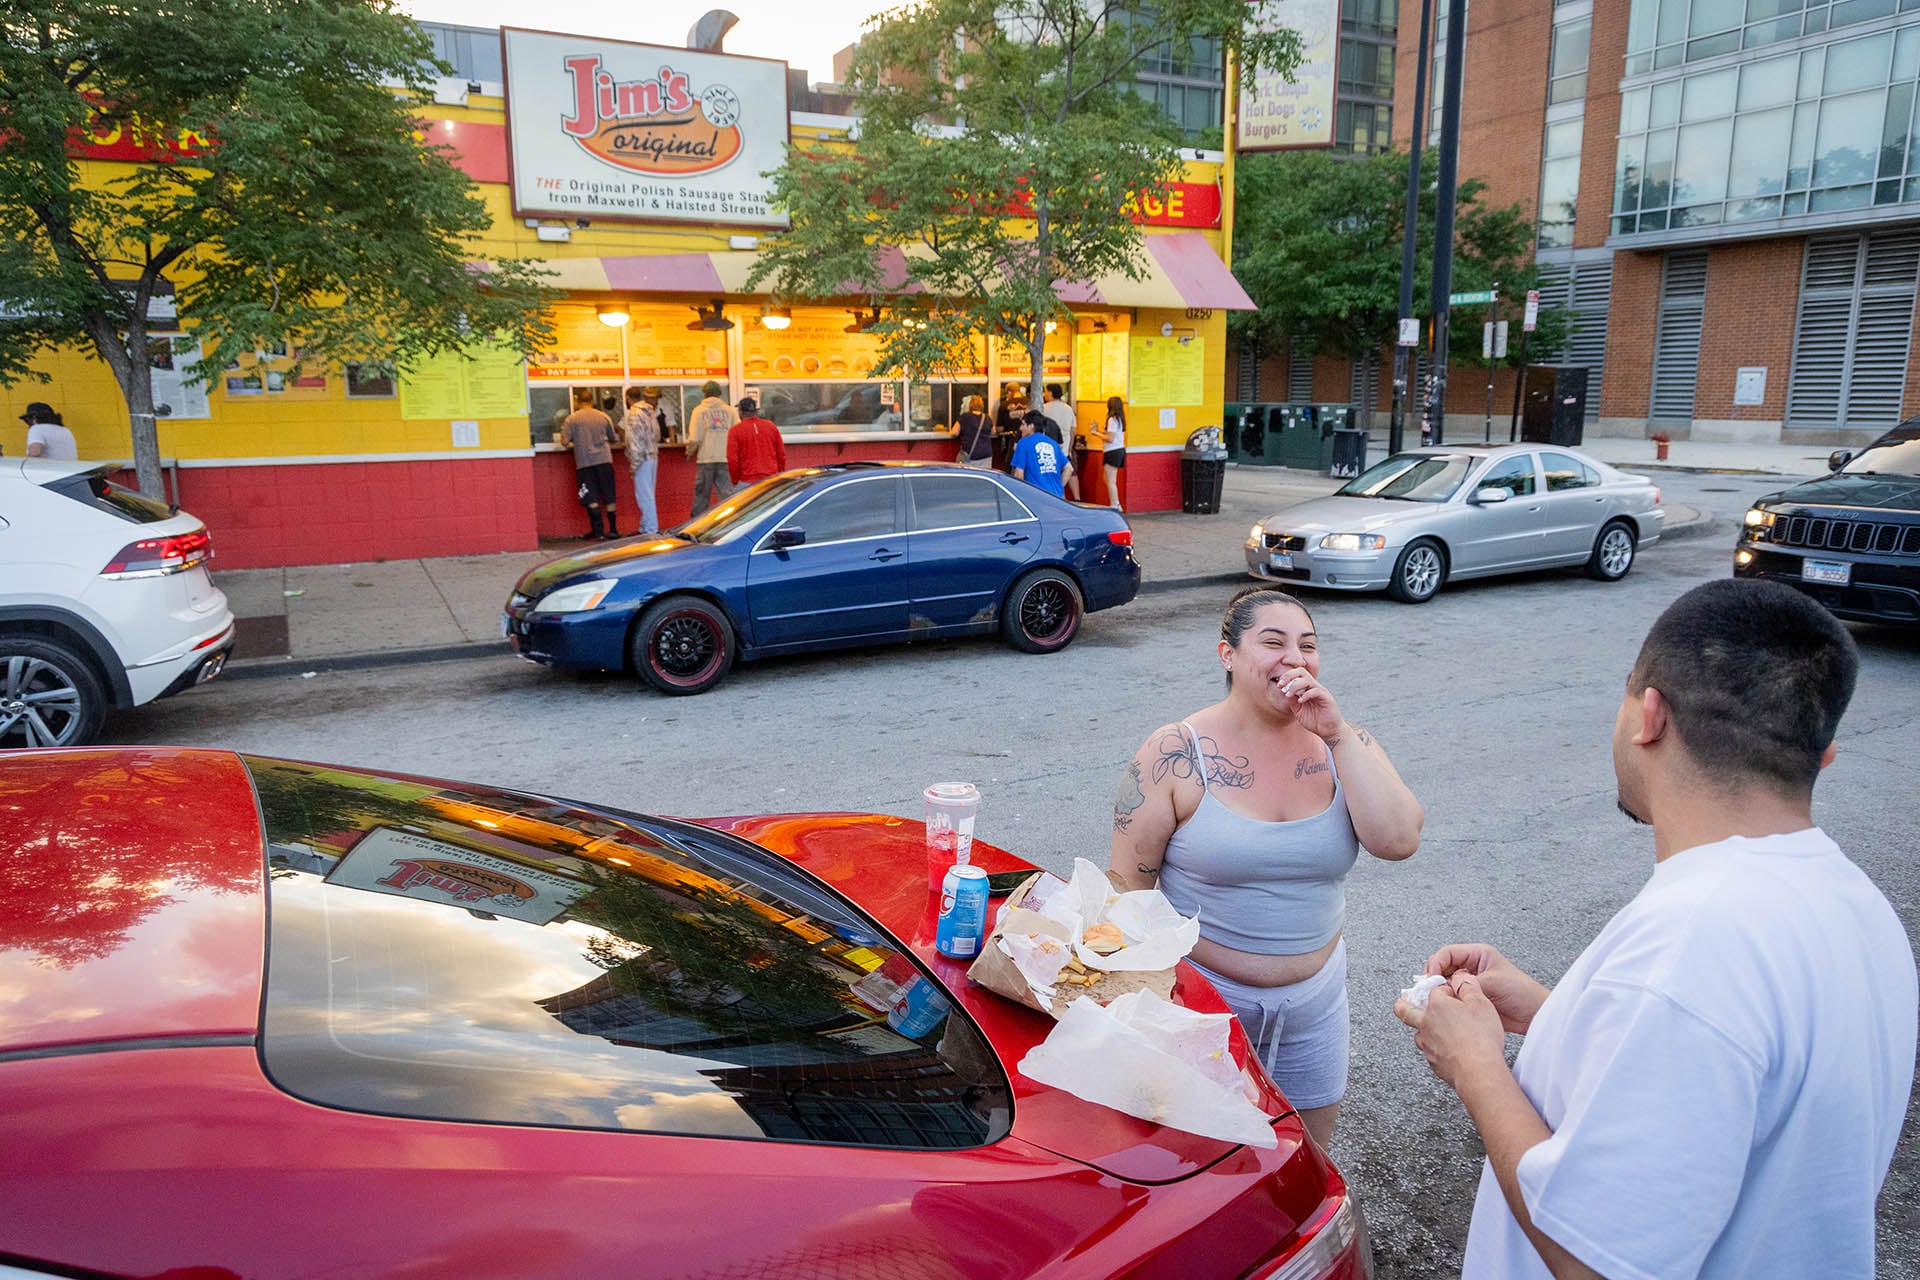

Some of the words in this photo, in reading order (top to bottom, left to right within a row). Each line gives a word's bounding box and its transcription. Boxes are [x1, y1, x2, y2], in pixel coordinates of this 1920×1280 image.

[561, 54, 694, 138] Jim's
[1245, 101, 1265, 118] Hot
[1268, 101, 1295, 119] Dogs
[1245, 121, 1288, 139] Burgers
[614, 130, 718, 161] original
[536, 176, 563, 190] THE
[569, 179, 626, 193] Original
[632, 184, 674, 197] Polish
[680, 186, 734, 201] Sausage
[739, 191, 771, 203] Stan
[549, 192, 582, 203] from
[588, 194, 645, 208] Maxwell
[651, 198, 660, 209] &
[666, 199, 716, 212] Halsted
[721, 202, 767, 215] Streets
[547, 368, 564, 376] PAY
[567, 368, 590, 376] HERE
[654, 368, 683, 376] ORDER
[685, 368, 707, 376] HERE
